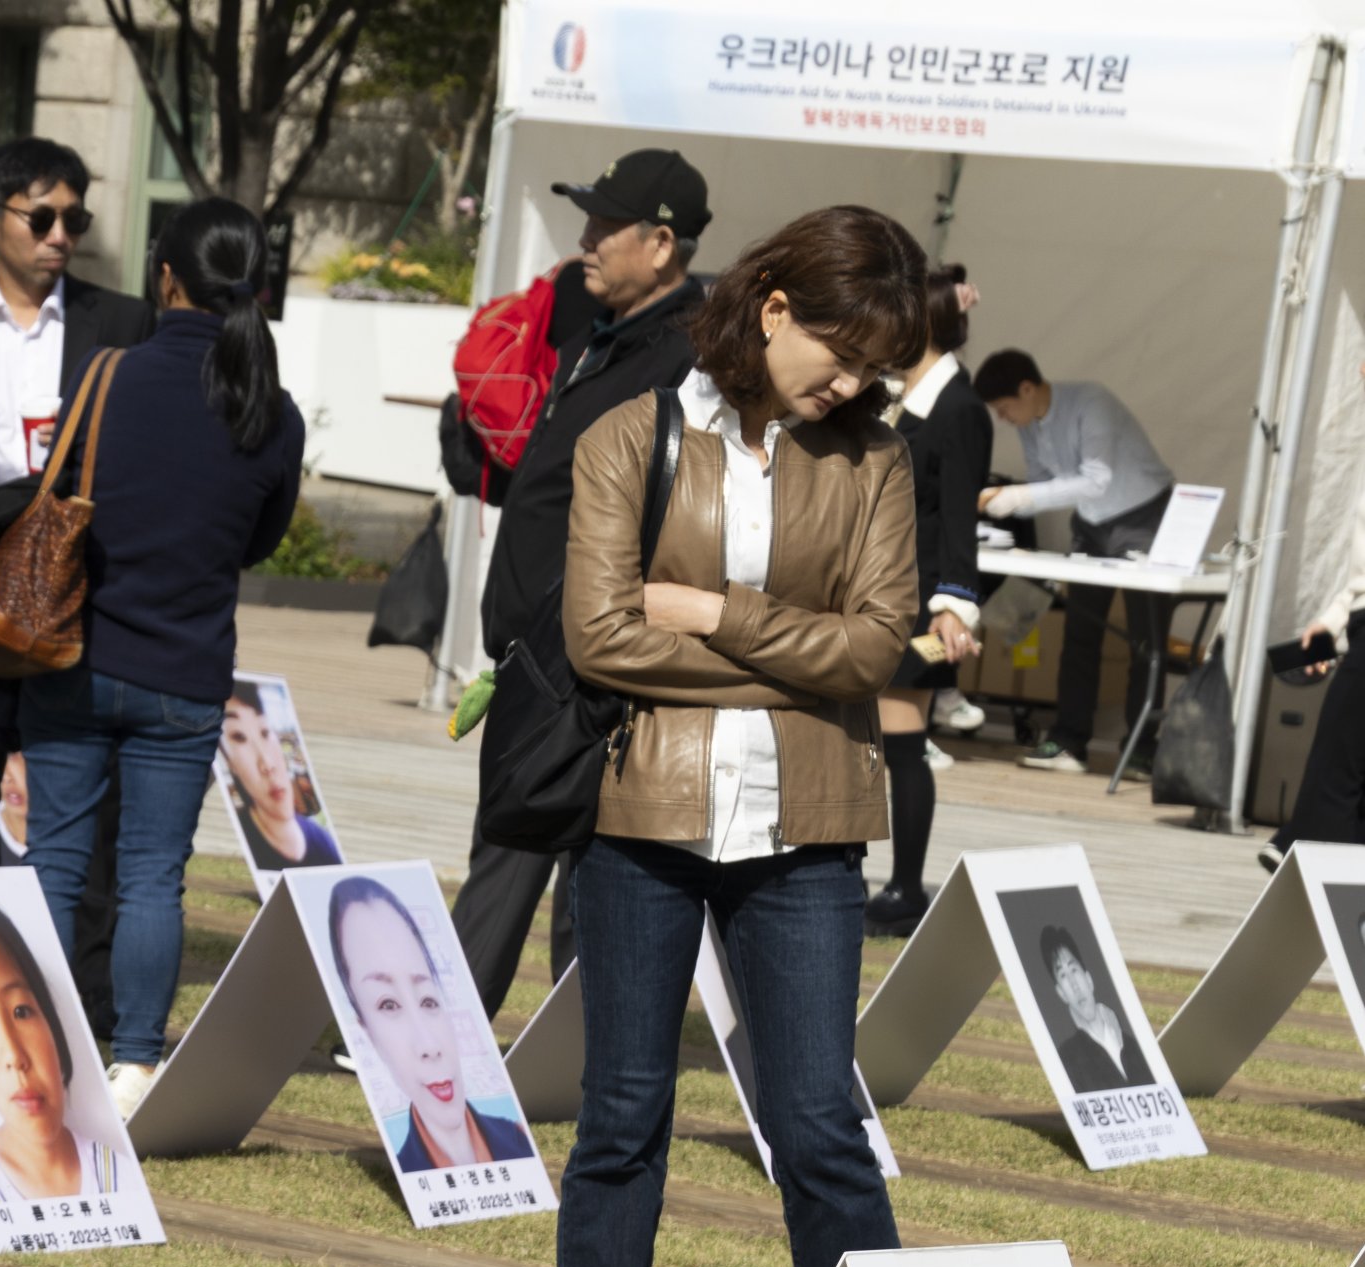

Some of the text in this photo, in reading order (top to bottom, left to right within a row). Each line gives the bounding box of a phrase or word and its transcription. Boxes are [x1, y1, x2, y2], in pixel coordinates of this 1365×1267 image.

[717, 34, 1131, 94] 우크라이나 인민군포로 지원
[799, 85, 819, 98] Aid
[824, 87, 841, 100] for
[845, 88, 882, 102] North
[886, 91, 932, 105] Korean
[937, 94, 989, 110] Soldiers
[994, 98, 1052, 113] Detained
[1074, 103, 1127, 117] Ukraine
[478, 1194, 512, 1209] 2023년
[11, 1232, 59, 1252] 실종일자
[69, 1227, 112, 1244] 2023년
[114, 1224, 141, 1240] 10월
